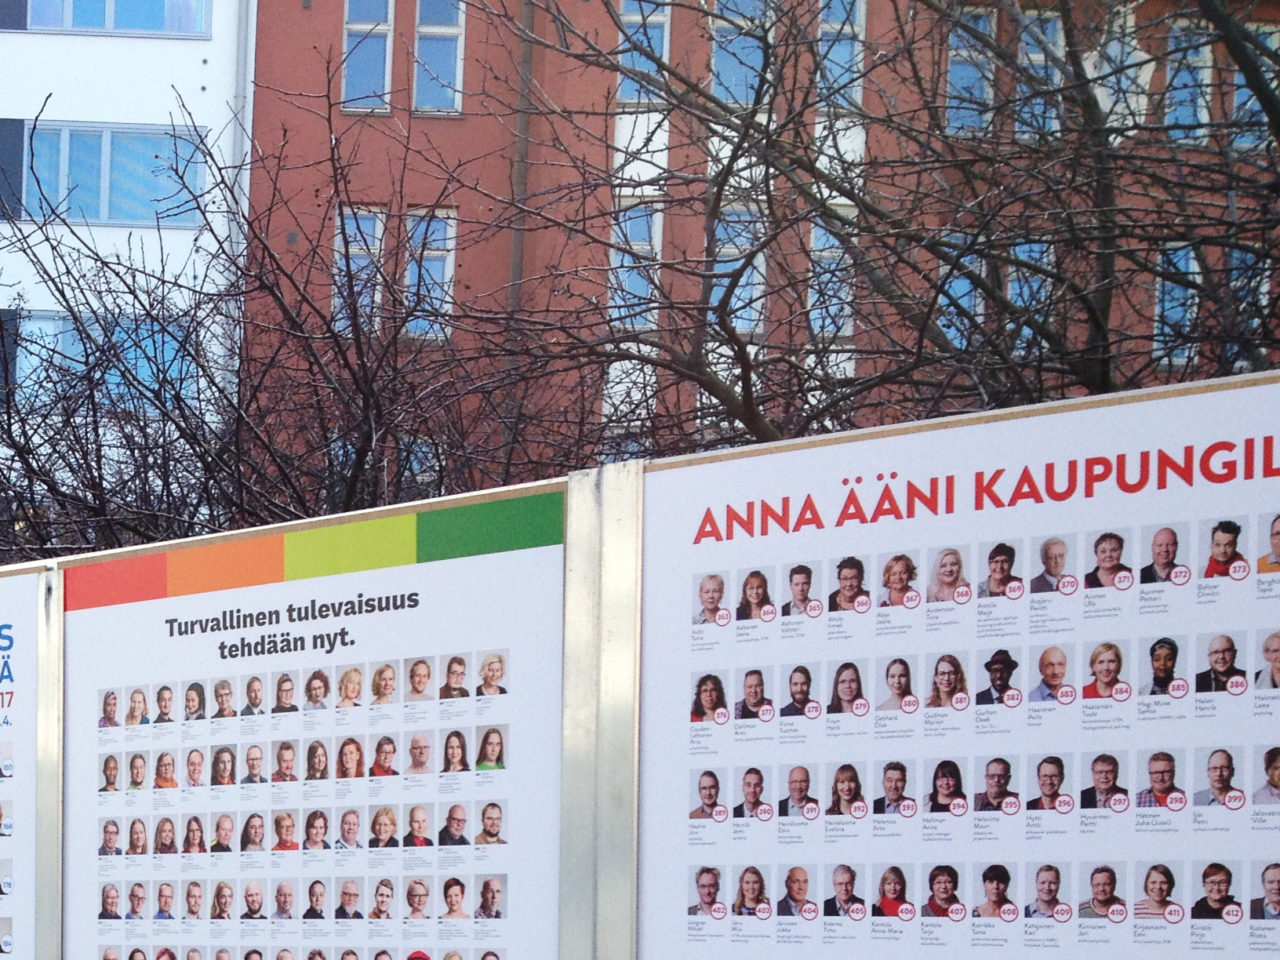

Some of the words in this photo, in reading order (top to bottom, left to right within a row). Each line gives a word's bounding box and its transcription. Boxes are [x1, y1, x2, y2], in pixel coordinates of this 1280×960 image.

[693, 493, 825, 545] ANNA
[835, 471, 955, 528] ÄÄNI
[974, 434, 1280, 511] KAUPUNGIL
[1232, 565, 1248, 574] 373
[1117, 576, 1130, 584] 371
[1061, 580, 1076, 589] 370
[1008, 585, 1023, 593] 369
[165, 606, 280, 638] Turvallinen
[286, 591, 420, 626] tulevaisuus
[218, 630, 306, 660] tehdään
[312, 627, 356, 655] nyt.
[1060, 690, 1074, 698] 383
[1114, 687, 1129, 695] 384
[1006, 693, 1020, 701] 382
[1112, 798, 1127, 806] 397
[1227, 795, 1244, 803] 399
[1053, 906, 1071, 916] 409
[1225, 909, 1240, 917] 412
